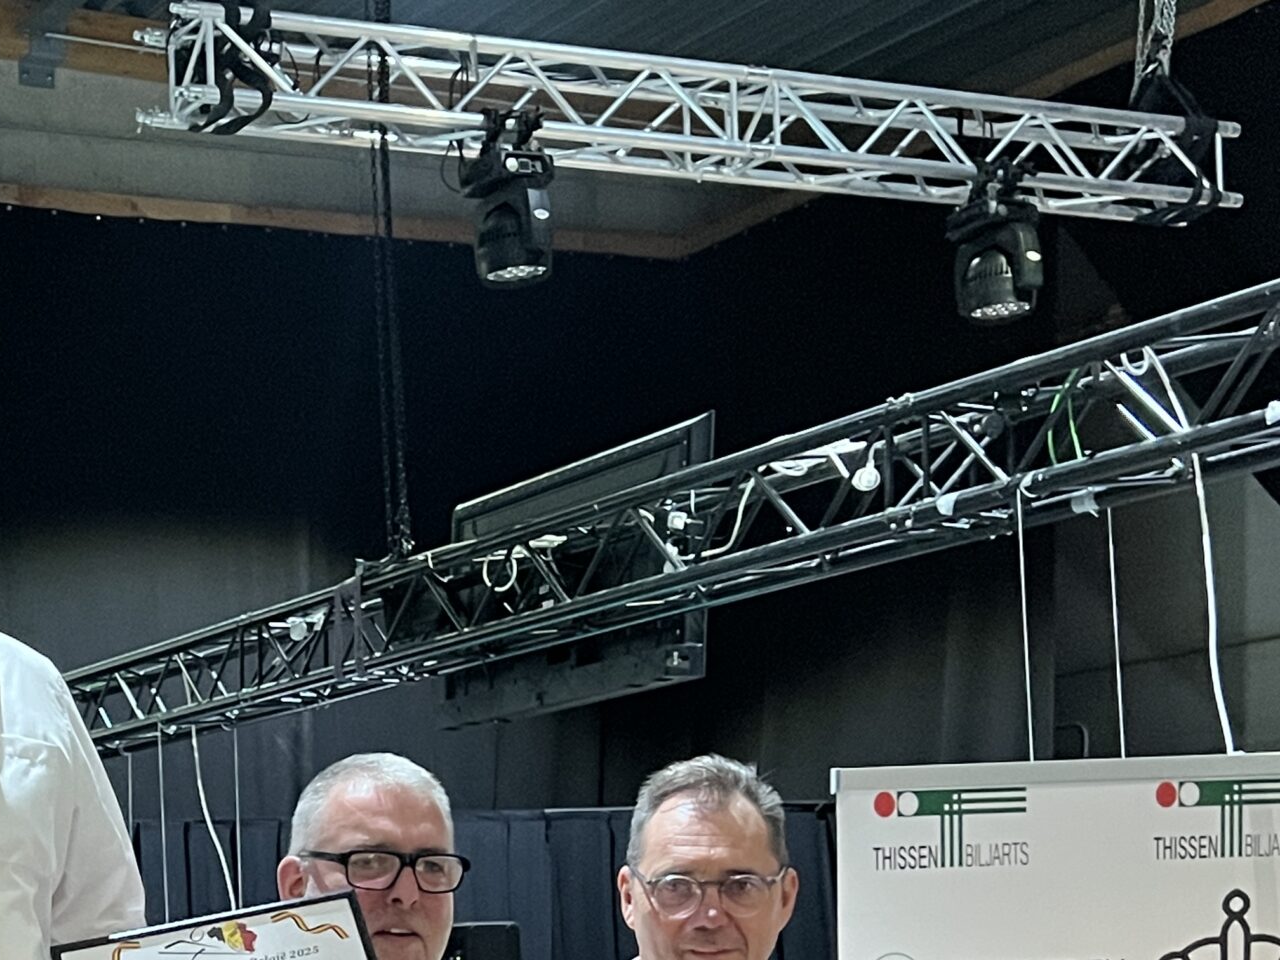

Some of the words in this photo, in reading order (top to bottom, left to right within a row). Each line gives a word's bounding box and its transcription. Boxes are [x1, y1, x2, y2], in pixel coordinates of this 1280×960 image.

[872, 845, 939, 871] THISSEN
[964, 842, 1030, 868] BILJARTS
[1153, 835, 1219, 861] THISSEN
[289, 946, 320, 960] 2025
